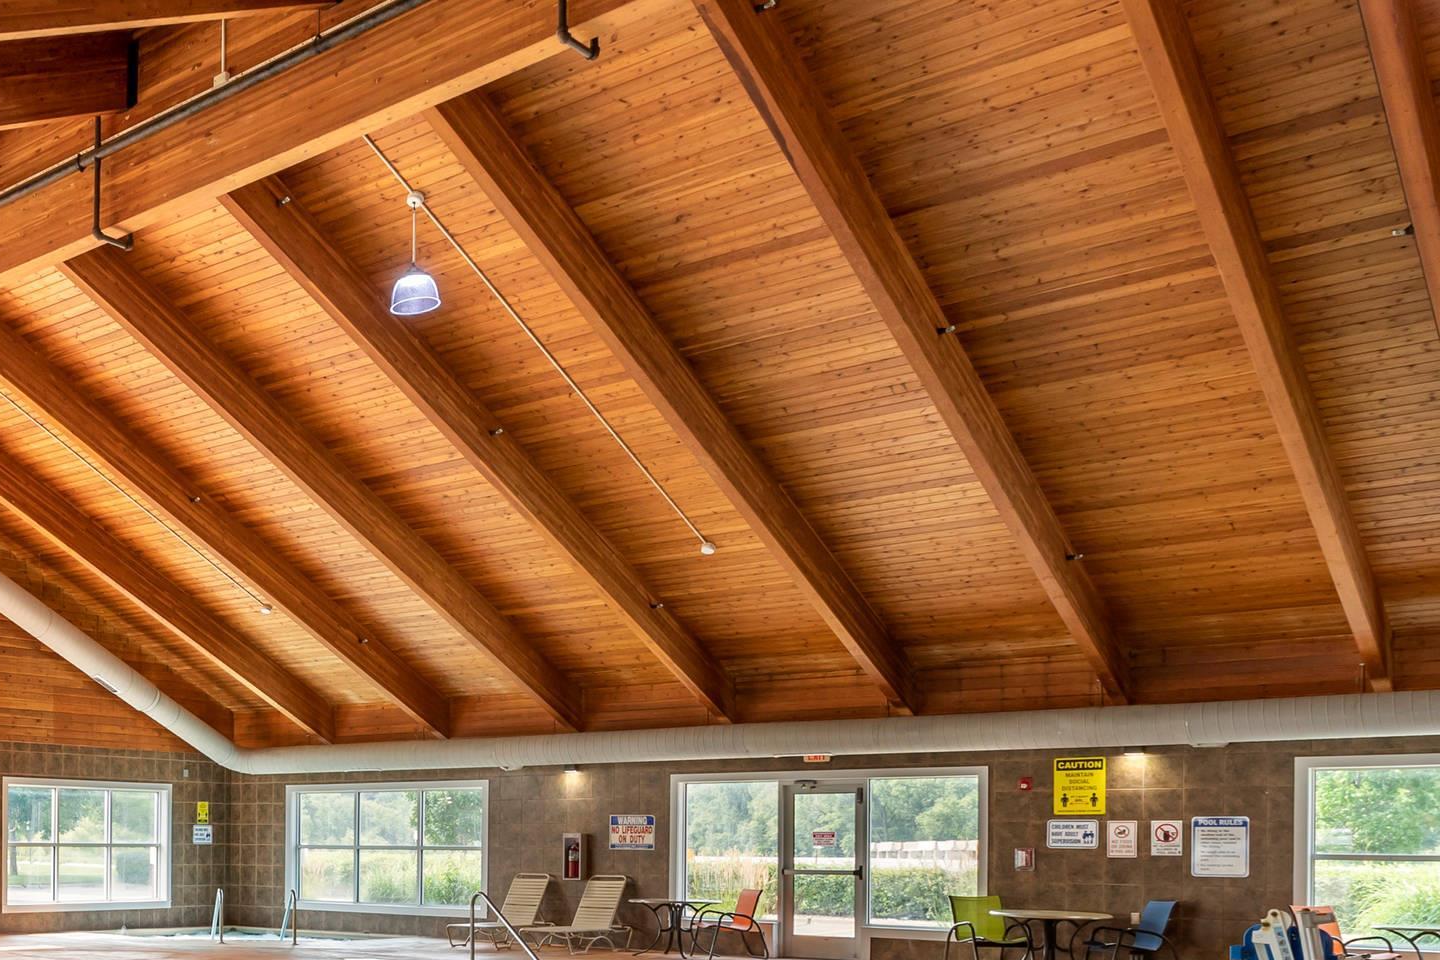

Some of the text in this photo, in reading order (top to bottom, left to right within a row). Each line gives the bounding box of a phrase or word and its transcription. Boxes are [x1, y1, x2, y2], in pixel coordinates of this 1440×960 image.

[1057, 761, 1102, 769] CAUTION
[617, 816, 647, 825] WARNING
[622, 825, 652, 834] LIFEGUARD
[618, 835, 646, 843] ON DUTY
